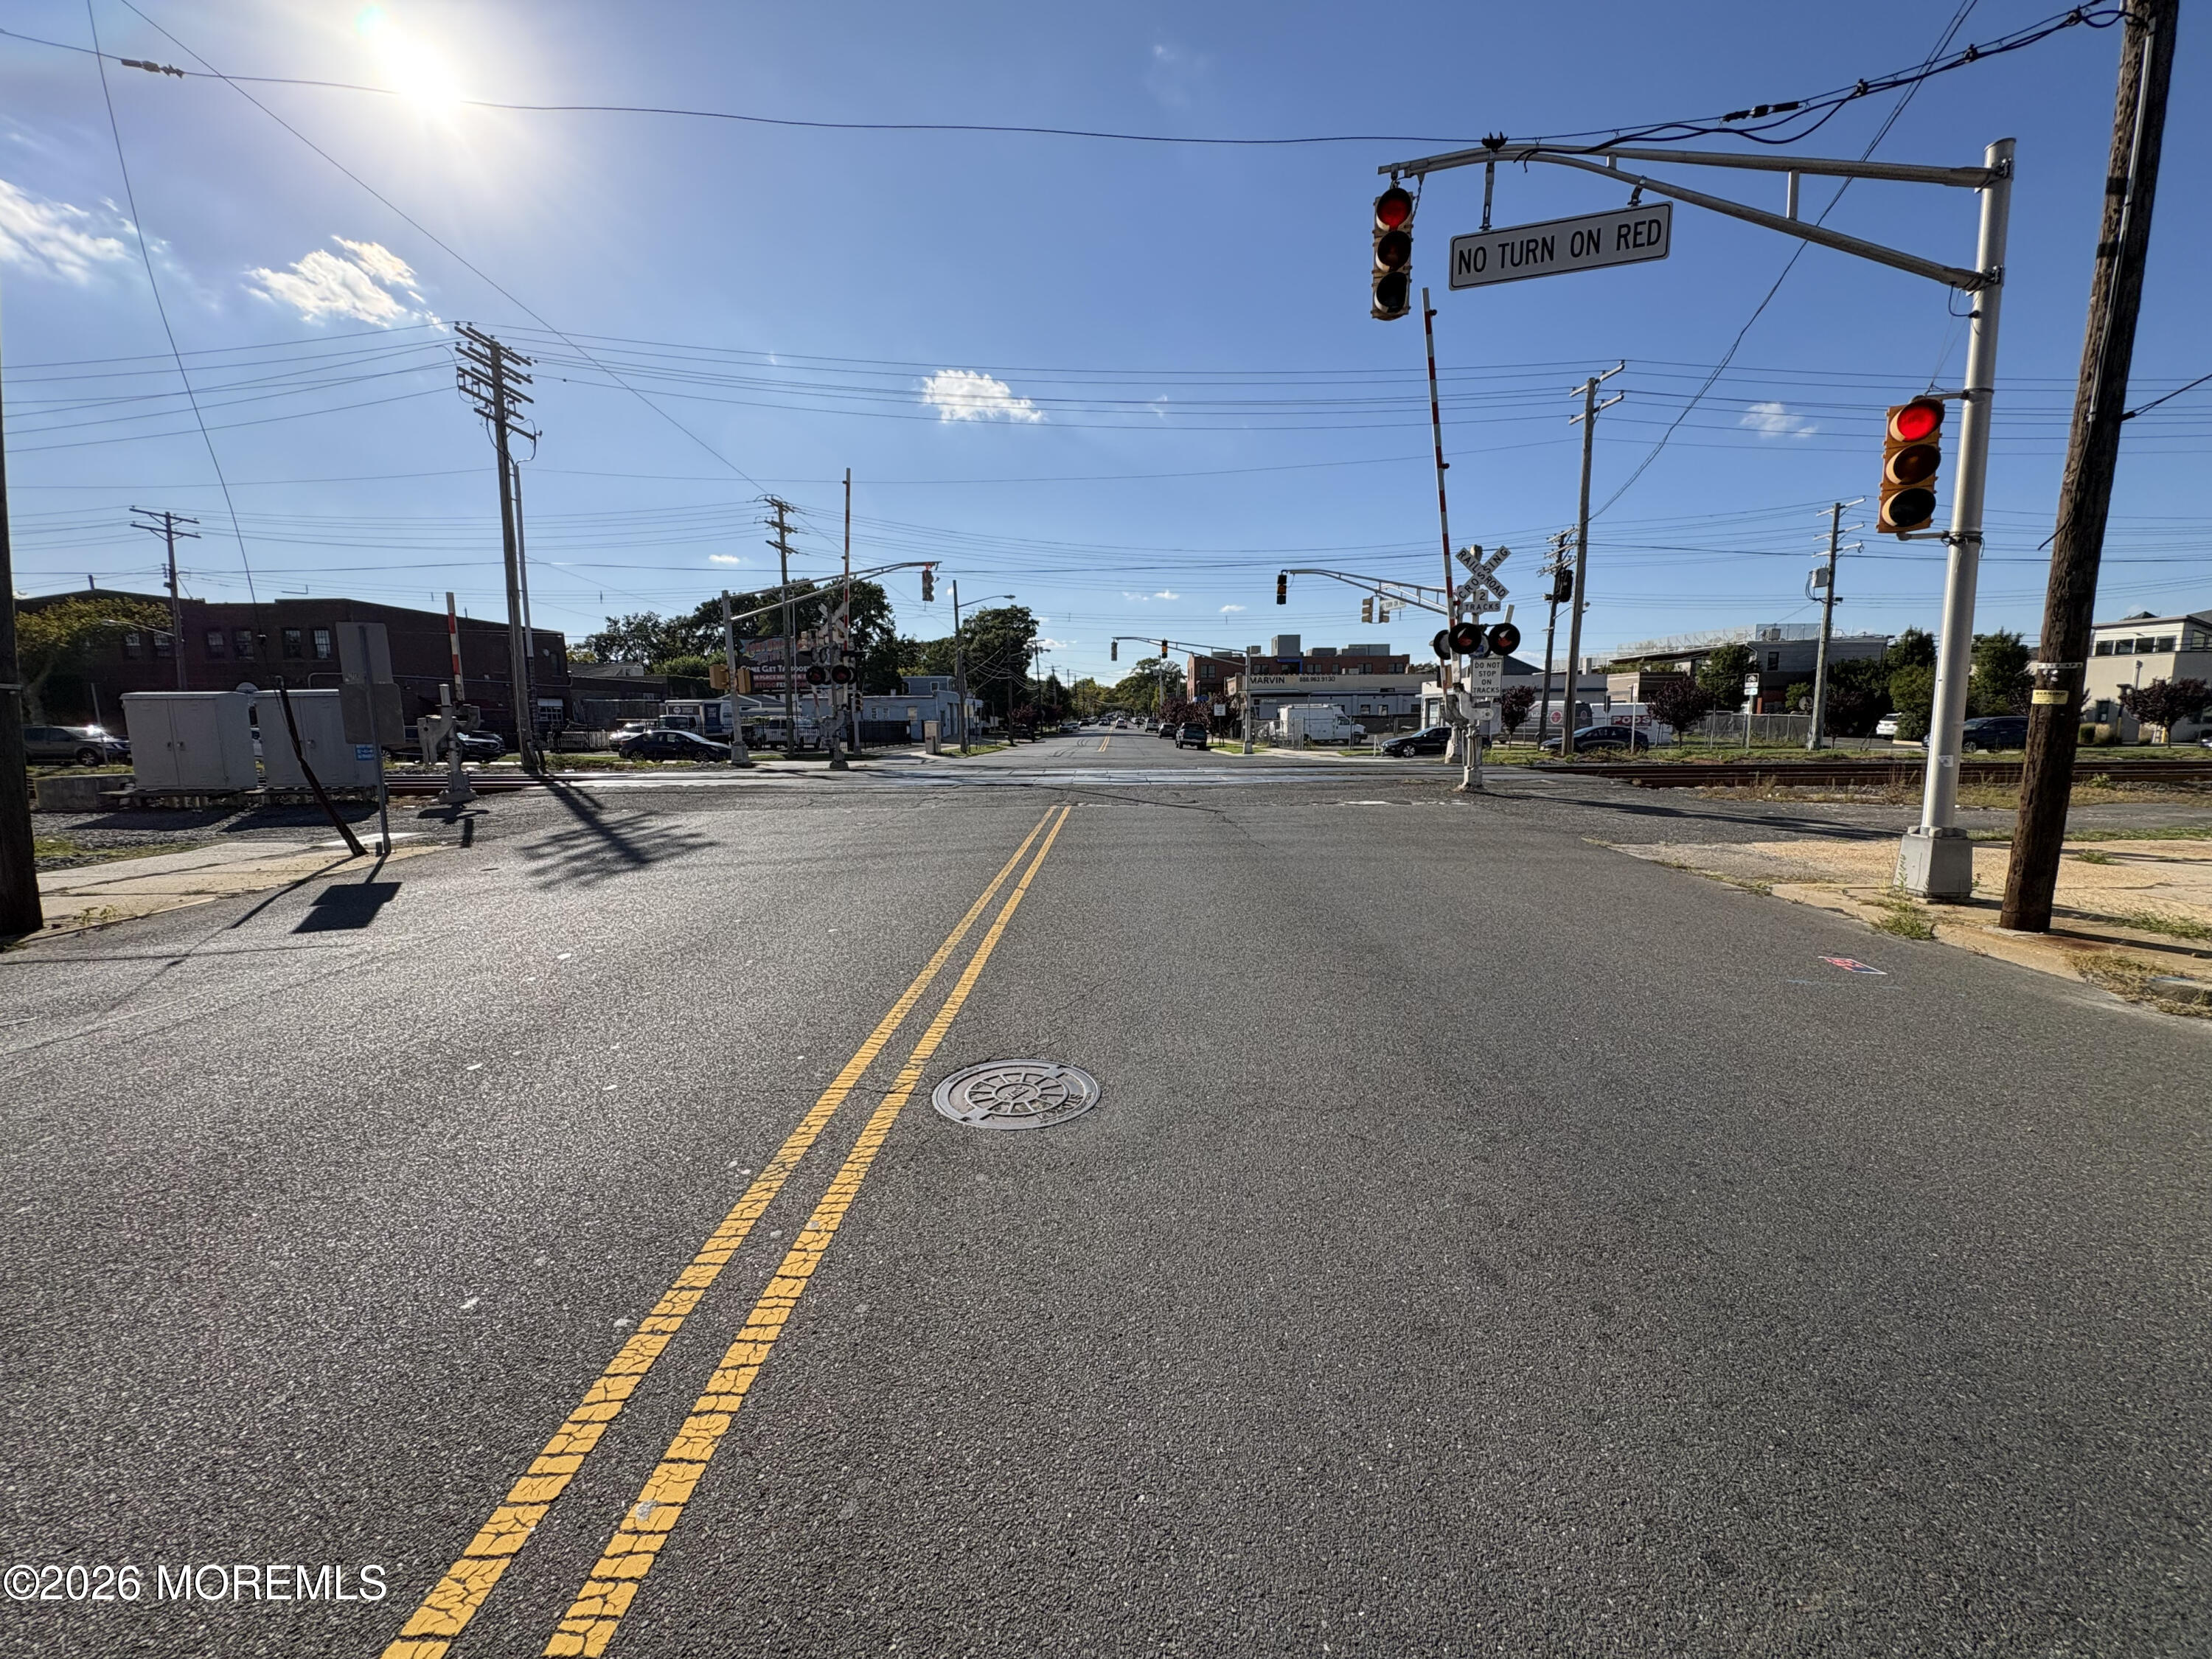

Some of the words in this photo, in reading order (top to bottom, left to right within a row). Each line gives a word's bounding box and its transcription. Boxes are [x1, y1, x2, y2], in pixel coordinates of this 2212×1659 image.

[1458, 246, 1486, 275] NO
[1498, 235, 1555, 269] TURN
[1571, 227, 1601, 258] ON
[1616, 219, 1661, 251] RED
[1458, 550, 1506, 597] RAILROAD
[1458, 548, 1508, 599] CROSSING
[1479, 592, 1486, 601] 2
[1250, 676, 1285, 684] MARVIN
